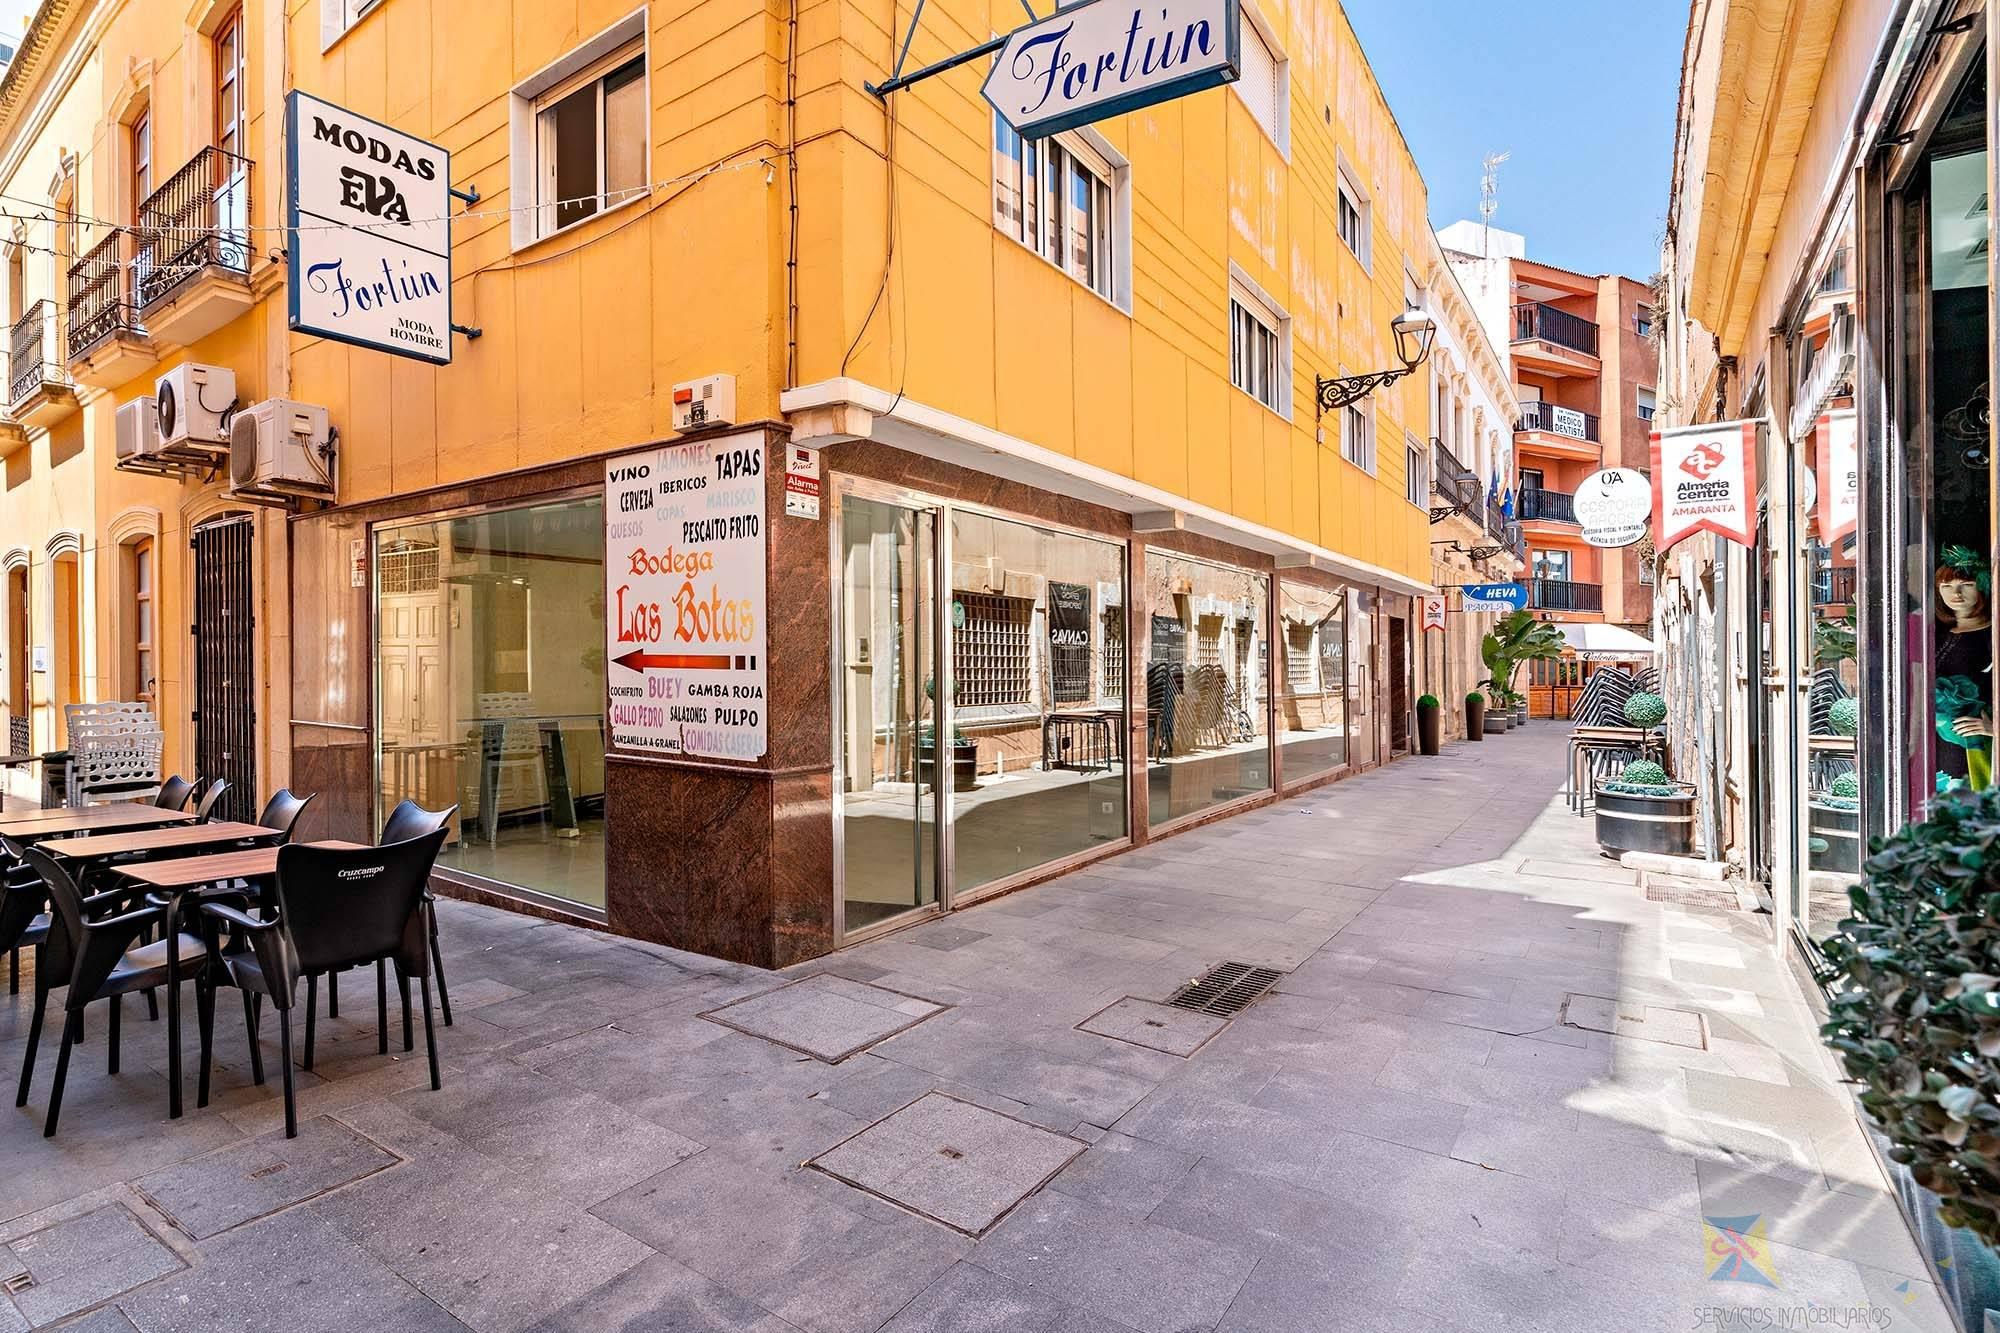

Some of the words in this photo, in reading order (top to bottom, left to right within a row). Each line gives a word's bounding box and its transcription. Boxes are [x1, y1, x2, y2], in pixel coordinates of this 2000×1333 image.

[1012, 8, 1216, 115] Fortún
[312, 116, 436, 182] MODAS
[339, 165, 411, 226] EVA
[306, 257, 442, 318] Fortún
[398, 317, 435, 336] MODA
[390, 327, 443, 350] HOMBRE
[1555, 423, 1585, 438] DENTISTA
[656, 443, 712, 473] JAMONES
[715, 448, 761, 481] TAPAS
[609, 465, 650, 483] VINO
[787, 475, 819, 491] Alarma
[659, 476, 707, 494] IBERICOS
[1677, 487, 1729, 500] centro
[620, 488, 654, 512] CERVEZA
[706, 487, 756, 508] MARISCO
[656, 505, 686, 521] COPAS
[1672, 504, 1736, 516] AMARANTA
[610, 520, 644, 539] QUESOS
[682, 517, 727, 545] PESCAITO
[729, 514, 759, 539] FRITO
[627, 544, 715, 579] Bodega
[1486, 587, 1517, 599] HEVA
[616, 584, 662, 643] Las
[671, 581, 755, 643] Botas
[610, 685, 643, 698] COCHIFRITO
[648, 675, 683, 699] BUEY
[688, 684, 729, 698] GAMBA
[732, 685, 763, 699] ROJA
[613, 704, 637, 726] GALLO
[638, 704, 664, 729] PEDRO
[670, 705, 707, 724] SALAZONES
[715, 707, 759, 727] PULPO
[654, 737, 681, 750] GRANEL
[685, 729, 723, 753] COMIDAS
[338, 866, 385, 877] Cruzcampo
